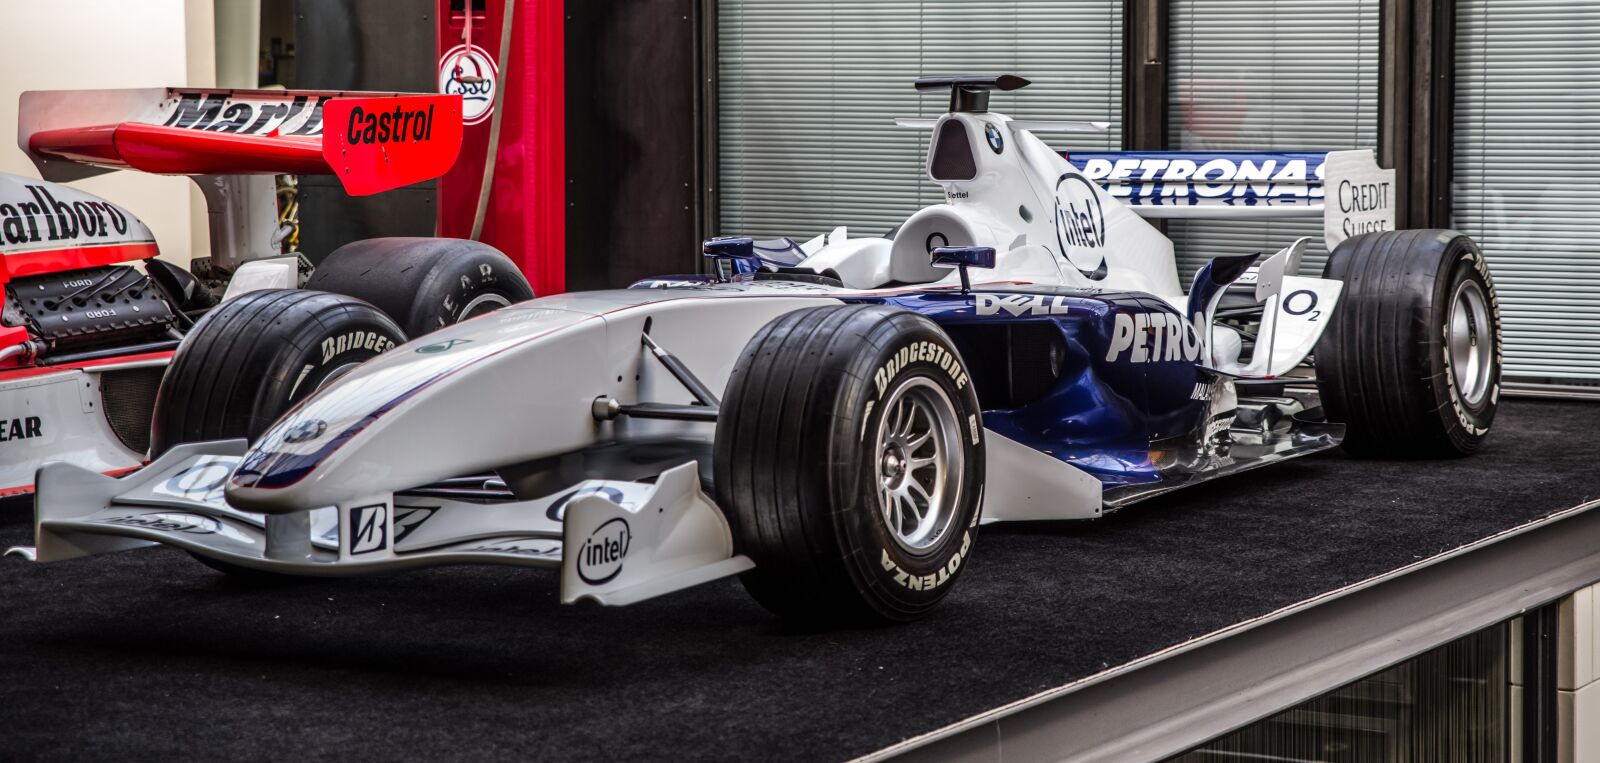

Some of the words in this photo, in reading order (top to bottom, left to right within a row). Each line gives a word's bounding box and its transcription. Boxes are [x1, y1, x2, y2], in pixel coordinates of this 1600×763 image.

[347, 104, 434, 145] Castrol
[0, 185, 127, 246] arlboro
[1055, 195, 1101, 249] intel
[63, 278, 93, 289] FORD
[86, 309, 117, 319] FORD
[975, 293, 1069, 318] DELL
[874, 340, 968, 401] BRIDGESTONE
[585, 531, 624, 567] intel
[880, 530, 972, 592] POTENZA
